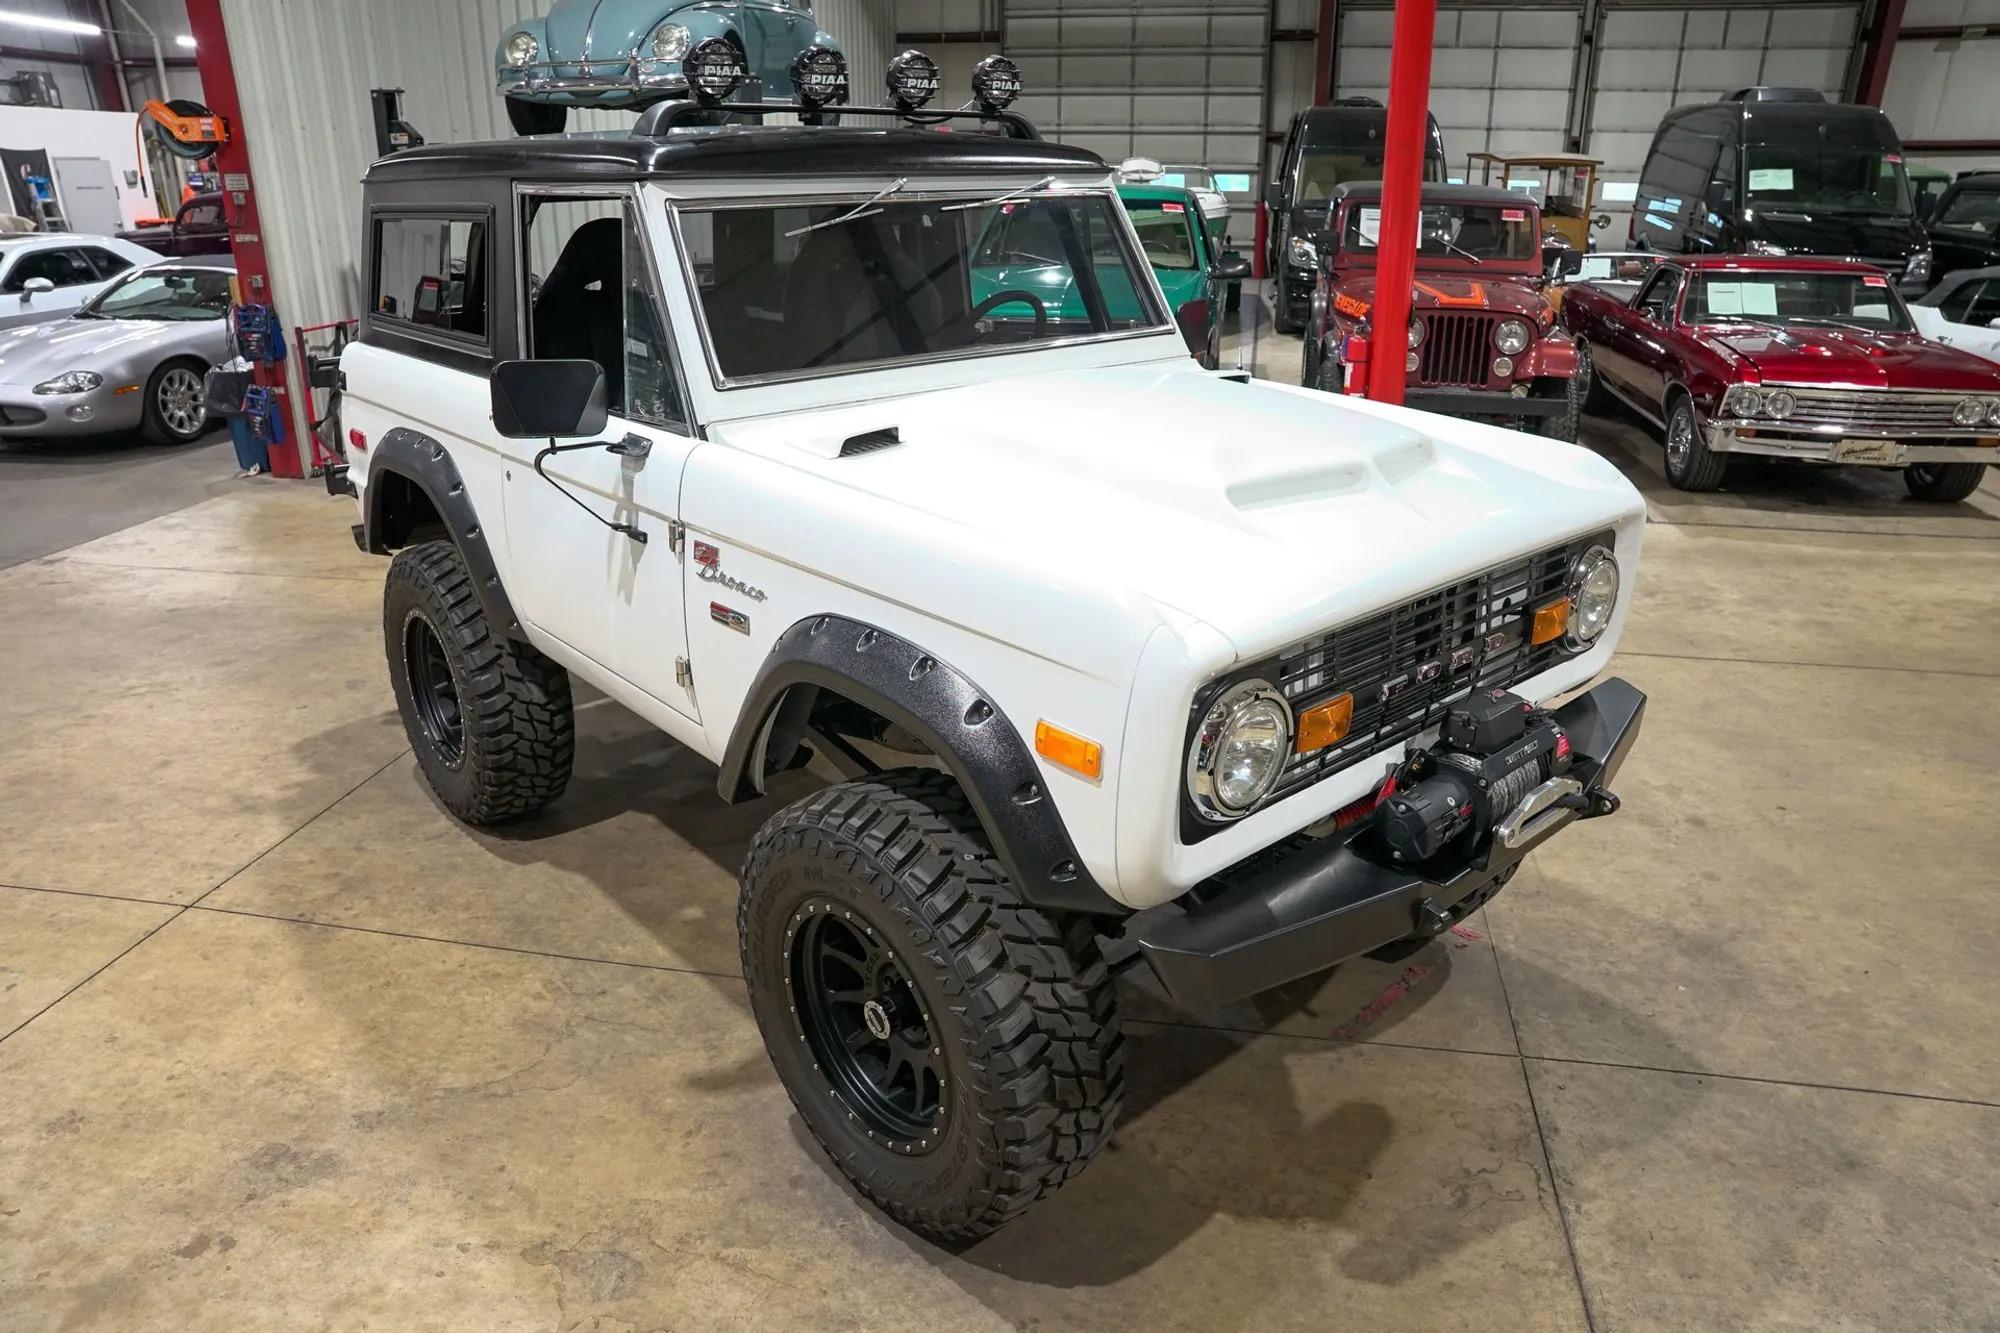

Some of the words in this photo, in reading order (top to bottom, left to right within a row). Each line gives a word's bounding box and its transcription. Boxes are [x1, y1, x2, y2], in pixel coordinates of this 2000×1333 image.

[704, 65, 743, 77] PIAA
[811, 74, 846, 86] PIAA
[907, 78, 939, 89] PIAA
[991, 80, 1021, 91] PIAA
[695, 560, 769, 602] Bronco
[1380, 632, 1506, 702] FORD
